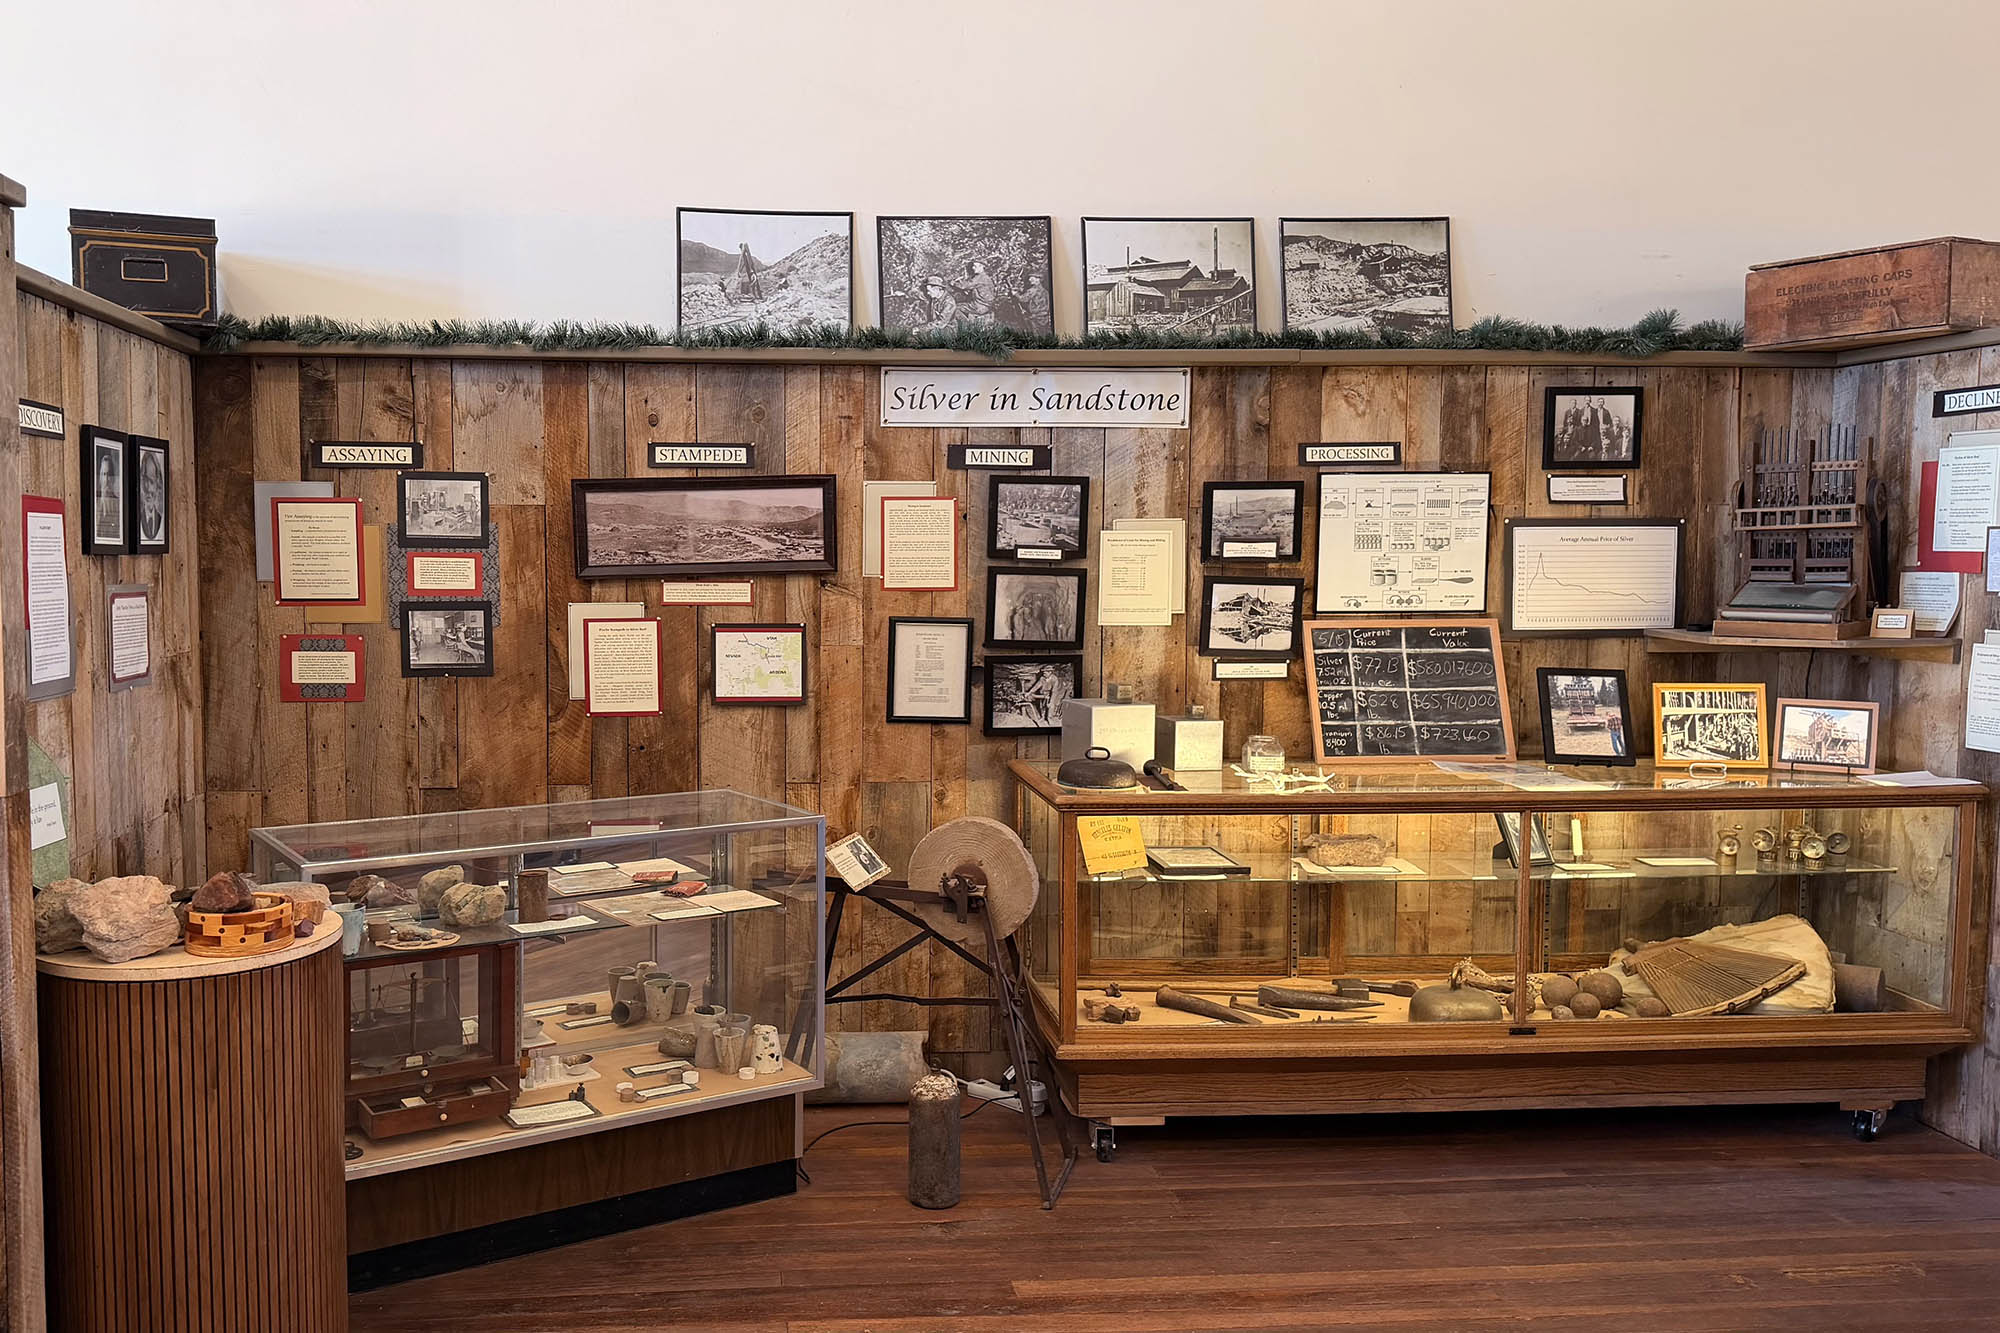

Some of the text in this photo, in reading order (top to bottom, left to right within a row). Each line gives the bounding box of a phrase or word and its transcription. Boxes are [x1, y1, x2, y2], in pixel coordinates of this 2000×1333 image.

[1775, 269, 1913, 297] ELECTRIC BLASTING CAPS
[890, 384, 1181, 411] Silver in Sandstone
[1949, 391, 2000, 409] DECLINE
[327, 448, 407, 463] ASSAYING
[659, 448, 743, 462] STAMPEDE
[970, 450, 1029, 464] MINING
[1310, 446, 1391, 461] PROCESSING
[1353, 629, 1391, 639] Current
[1429, 628, 1468, 638] Current
[1356, 638, 1377, 646] Price
[1317, 656, 1344, 666] Silver
[1318, 691, 1344, 701] Copper
